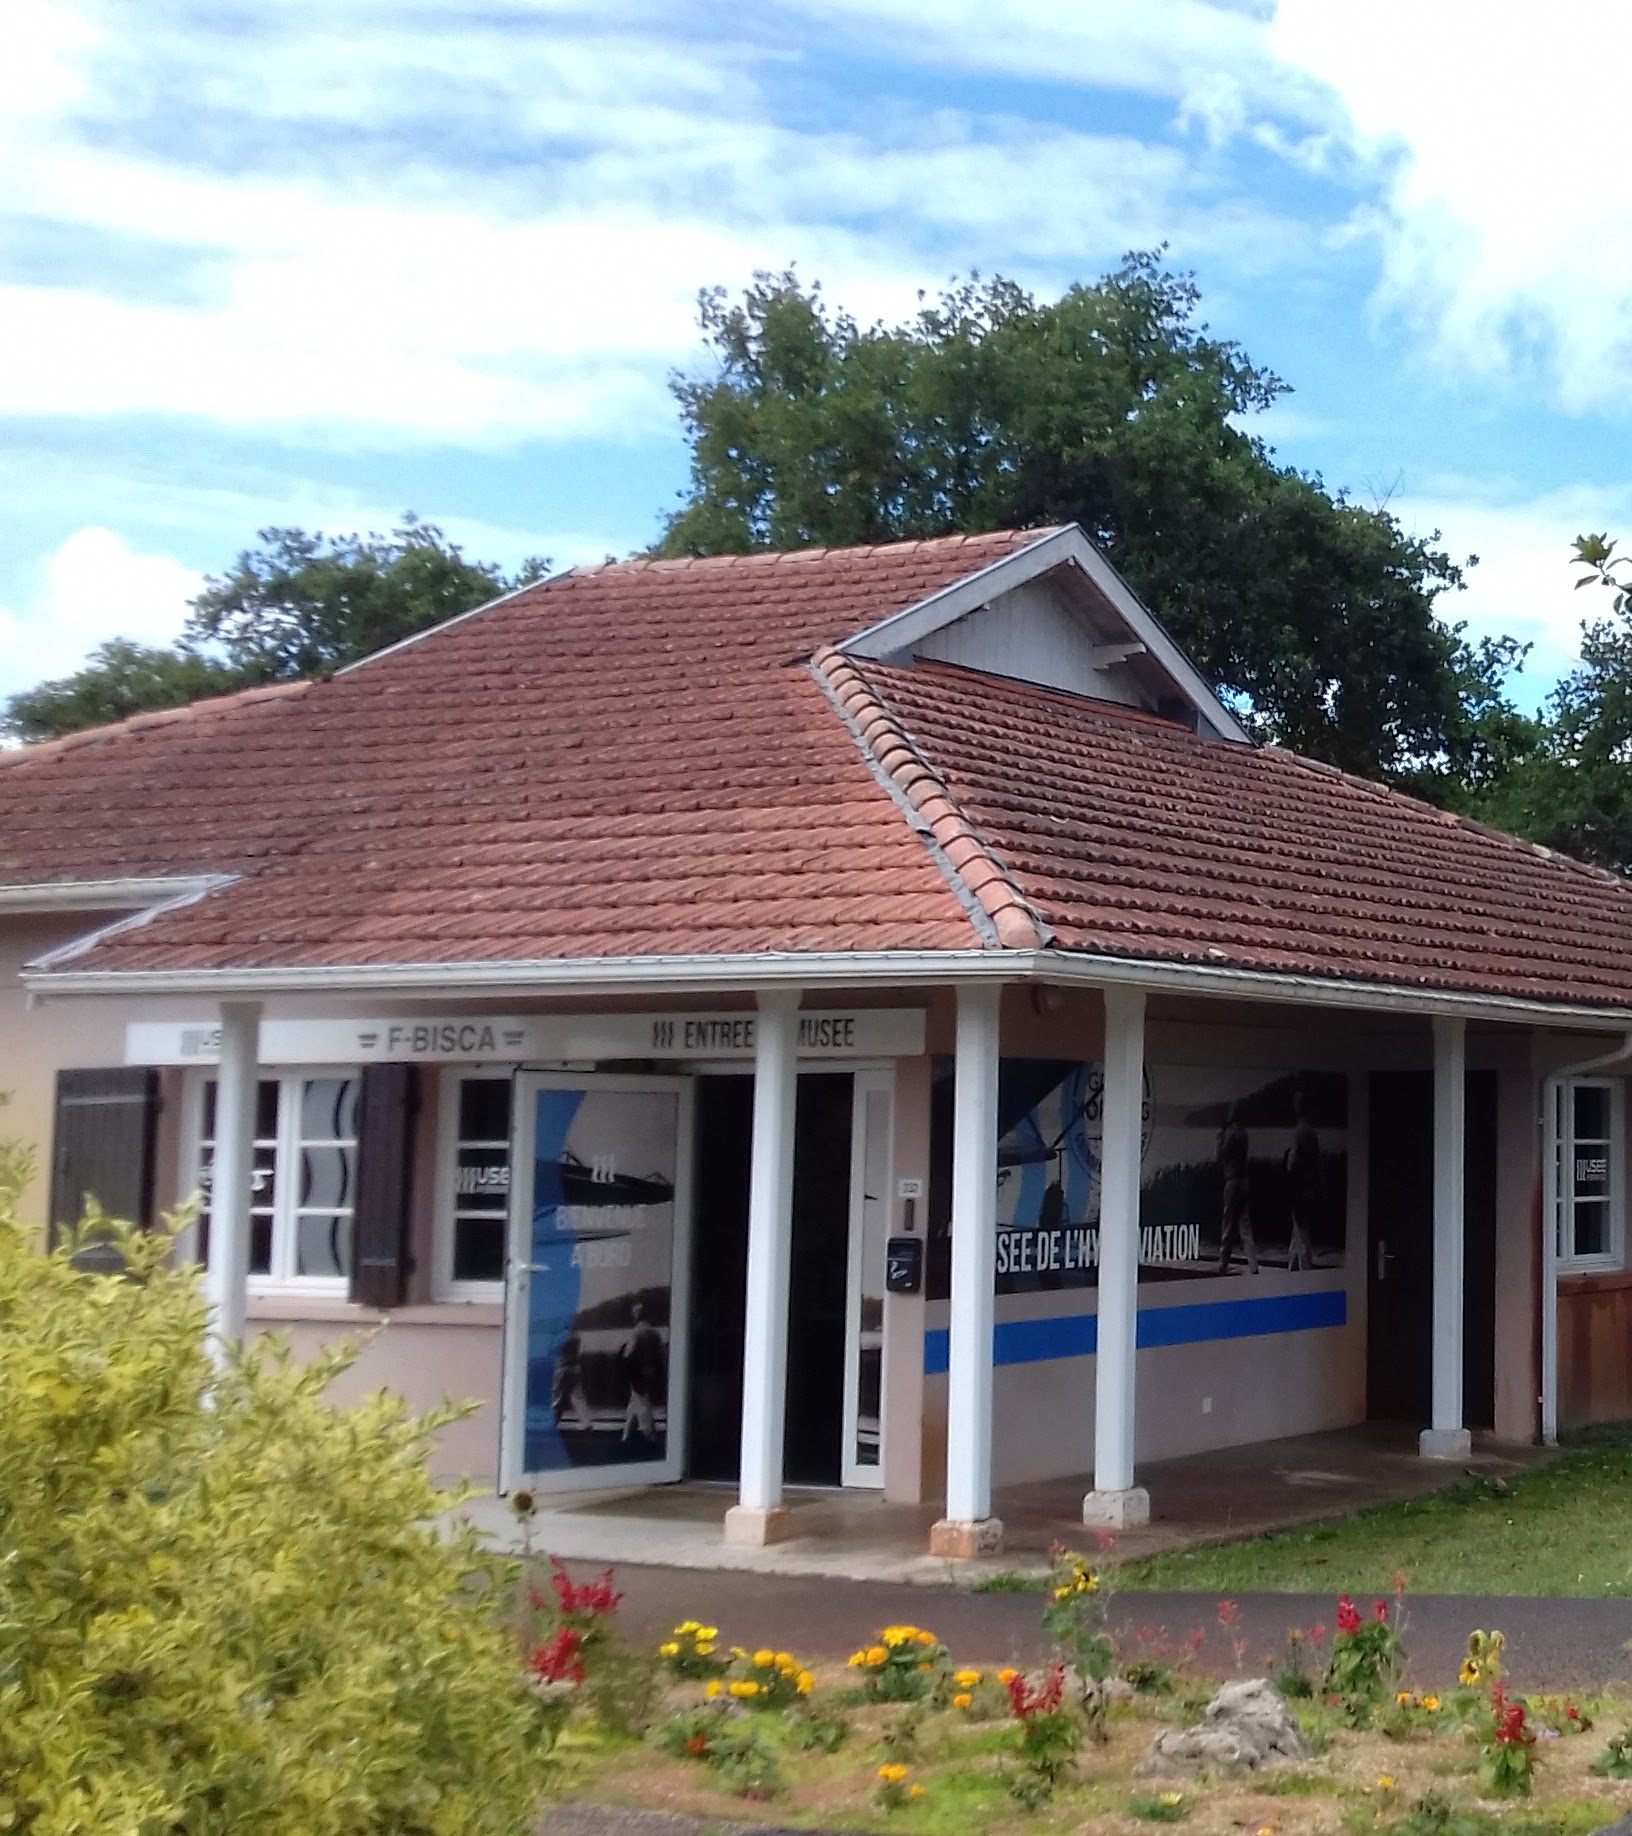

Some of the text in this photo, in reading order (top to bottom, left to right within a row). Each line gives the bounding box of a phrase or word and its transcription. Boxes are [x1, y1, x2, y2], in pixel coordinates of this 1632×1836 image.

[388, 1024, 496, 1052] F-BISCA
[684, 1020, 755, 1048] ENTREE
[1036, 1230, 1061, 1272] DE
